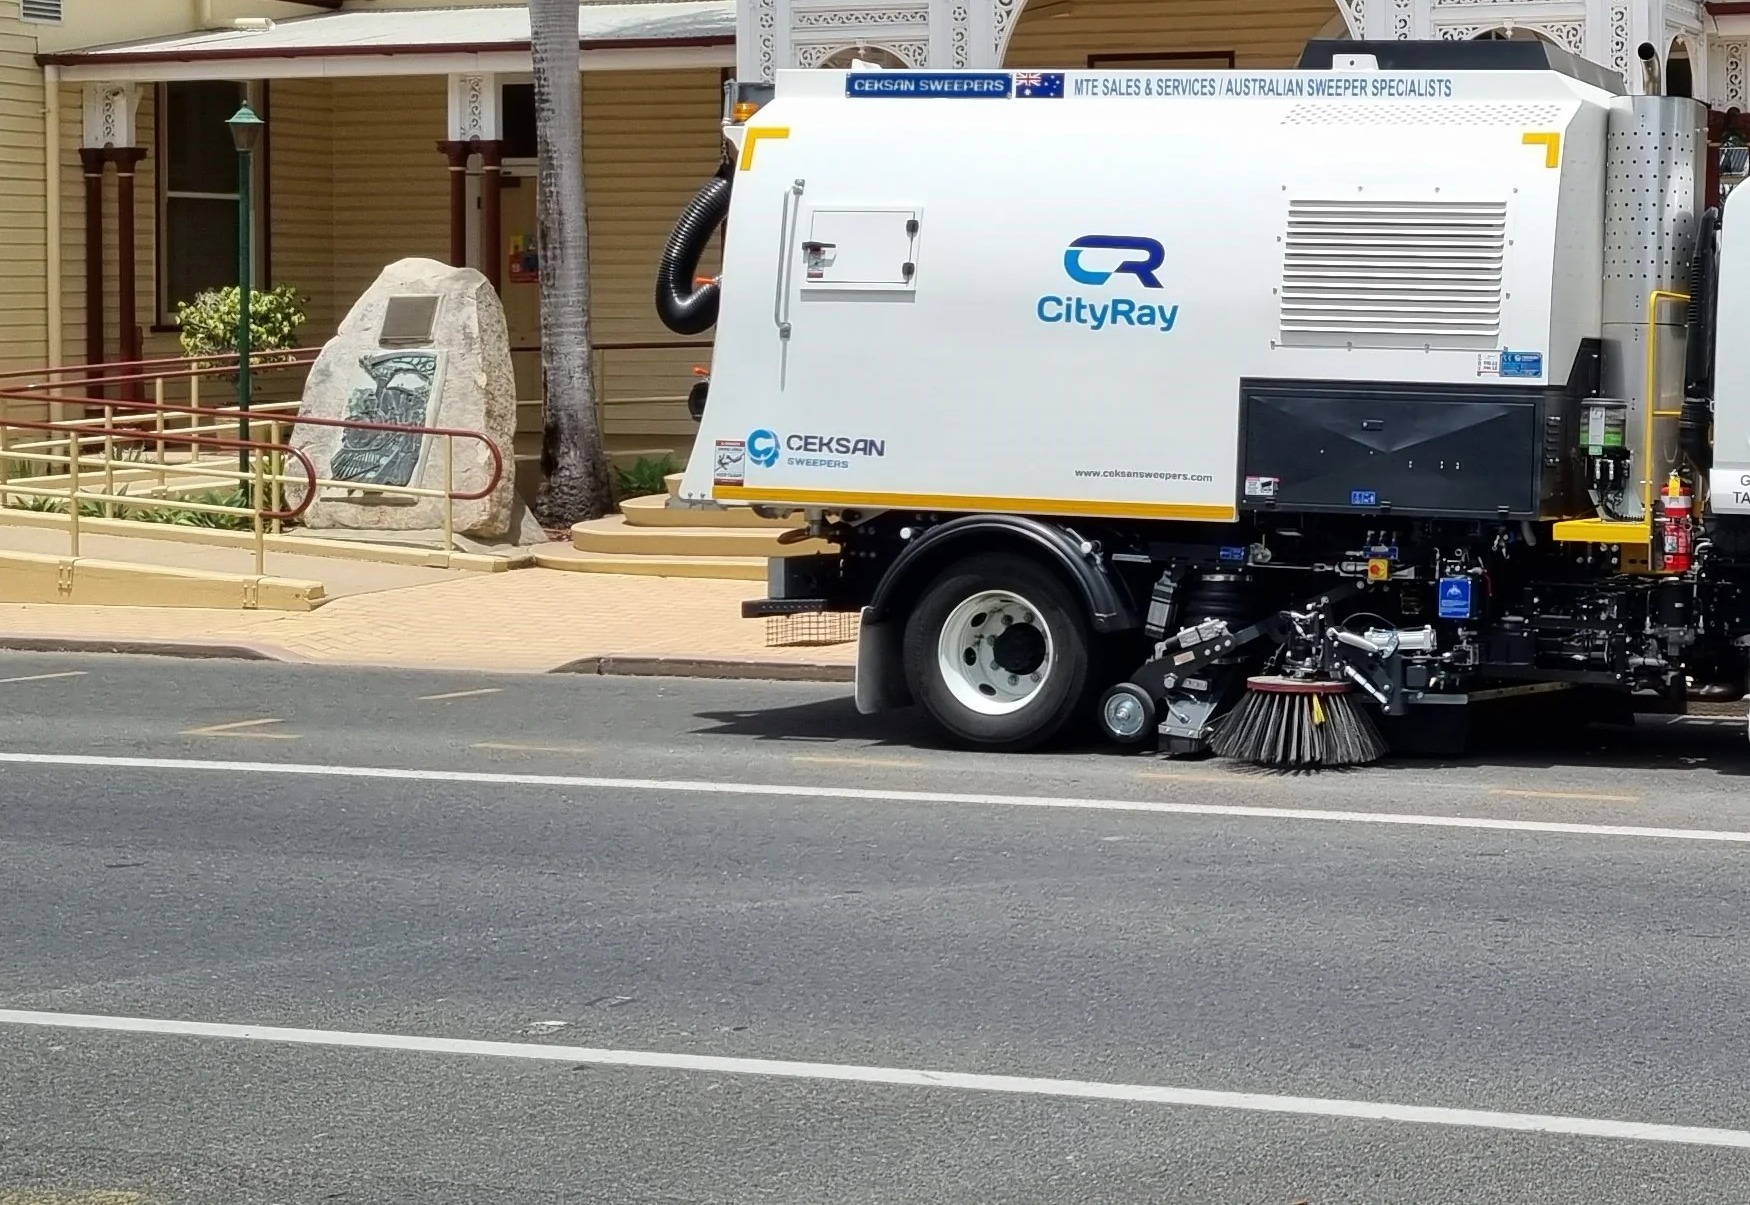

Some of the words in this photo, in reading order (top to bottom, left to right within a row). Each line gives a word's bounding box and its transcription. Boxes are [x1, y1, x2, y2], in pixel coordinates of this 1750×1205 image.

[854, 79, 915, 91] CEKSAN
[919, 79, 1005, 92] SWEEPERS
[1074, 78, 1099, 96] MTE
[1101, 78, 1141, 97] SALES
[1144, 78, 1153, 96] &
[1156, 77, 1216, 97] SERVICES
[1225, 77, 1304, 97] AUSTRALIAN
[1307, 78, 1368, 97] SWEEPER
[1371, 78, 1452, 98] SPECIALISTS
[1037, 295, 1179, 332] CityRay
[786, 434, 886, 457] CEKSAN
[787, 457, 849, 469] SWEEPERS
